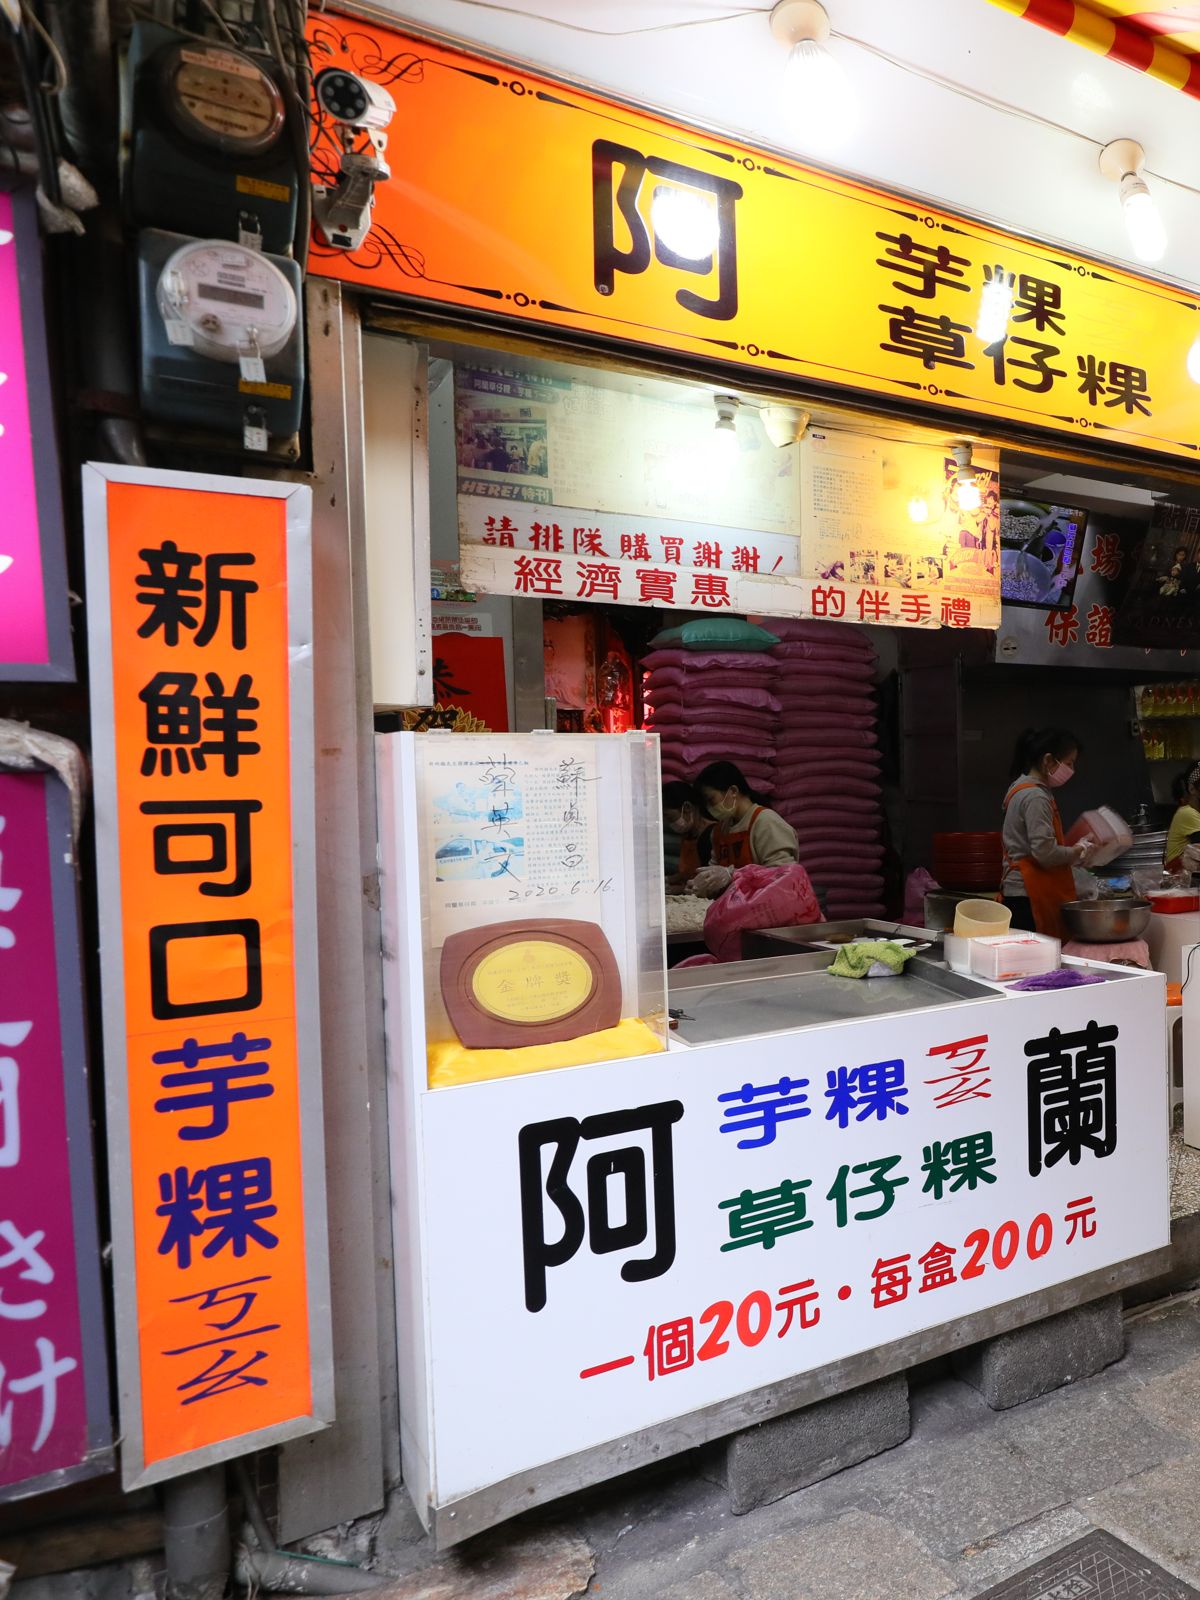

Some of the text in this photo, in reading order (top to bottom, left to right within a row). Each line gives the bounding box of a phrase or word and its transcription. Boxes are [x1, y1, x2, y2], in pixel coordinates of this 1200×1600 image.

[591, 139, 743, 321] 阿
[875, 230, 1066, 337] 芋粿
[877, 303, 1152, 417] 草仔粿
[513, 554, 972, 628] 經濟實惠 的伴手禮
[1045, 602, 1115, 648] 保證
[717, 1058, 909, 1150] 芋粿
[518, 1020, 1119, 1314] 阿 蘭
[717, 1131, 998, 1252] 草仔粿
